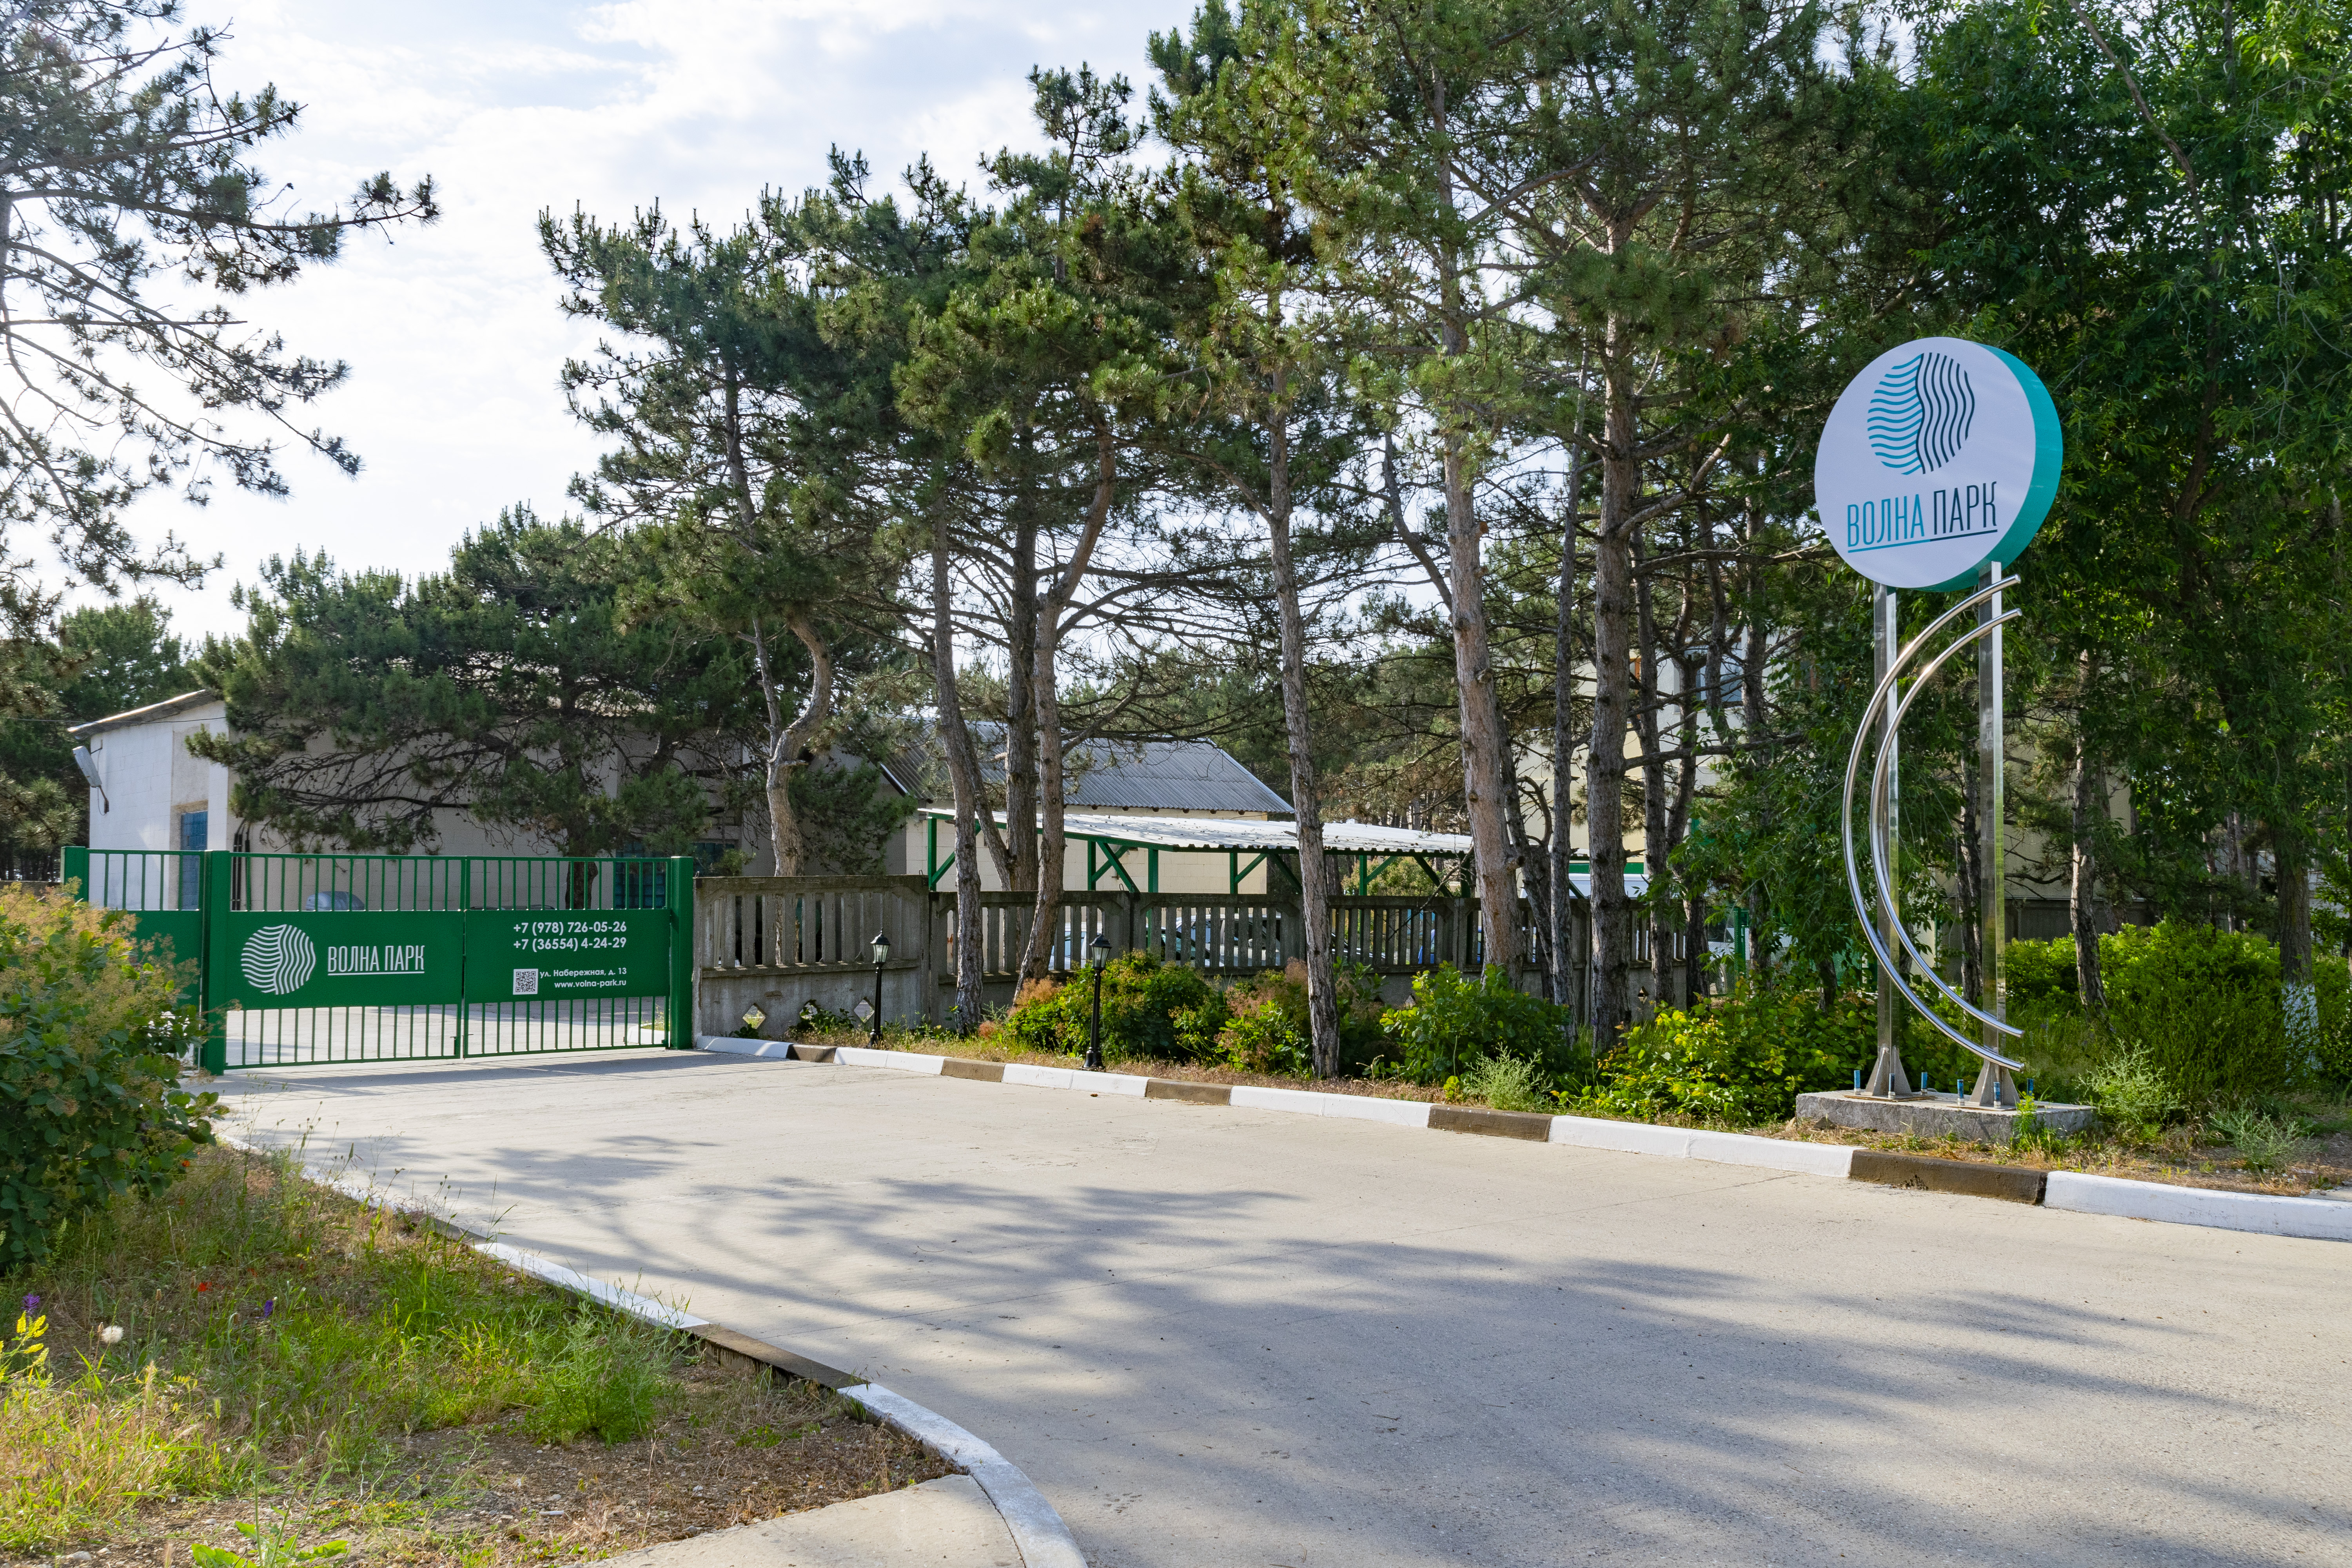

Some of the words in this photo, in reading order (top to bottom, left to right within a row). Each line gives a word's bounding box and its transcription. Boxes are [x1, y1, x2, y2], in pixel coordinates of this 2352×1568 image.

[1847, 494, 1925, 547] ВОЛНА
[1934, 481, 1997, 535] ПАРК
[514, 922, 528, 933] +7
[532, 922, 564, 936] (978)
[568, 921, 627, 933] 726-05-26
[514, 939, 528, 949] +7
[532, 938, 578, 952] (36554)
[581, 937, 626, 948] 4-24-29
[328, 946, 379, 972] ВОЛНА
[385, 946, 425, 970] ПАРК
[554, 969, 606, 977] Набережная,
[554, 979, 626, 988] www.volna-park.ru
